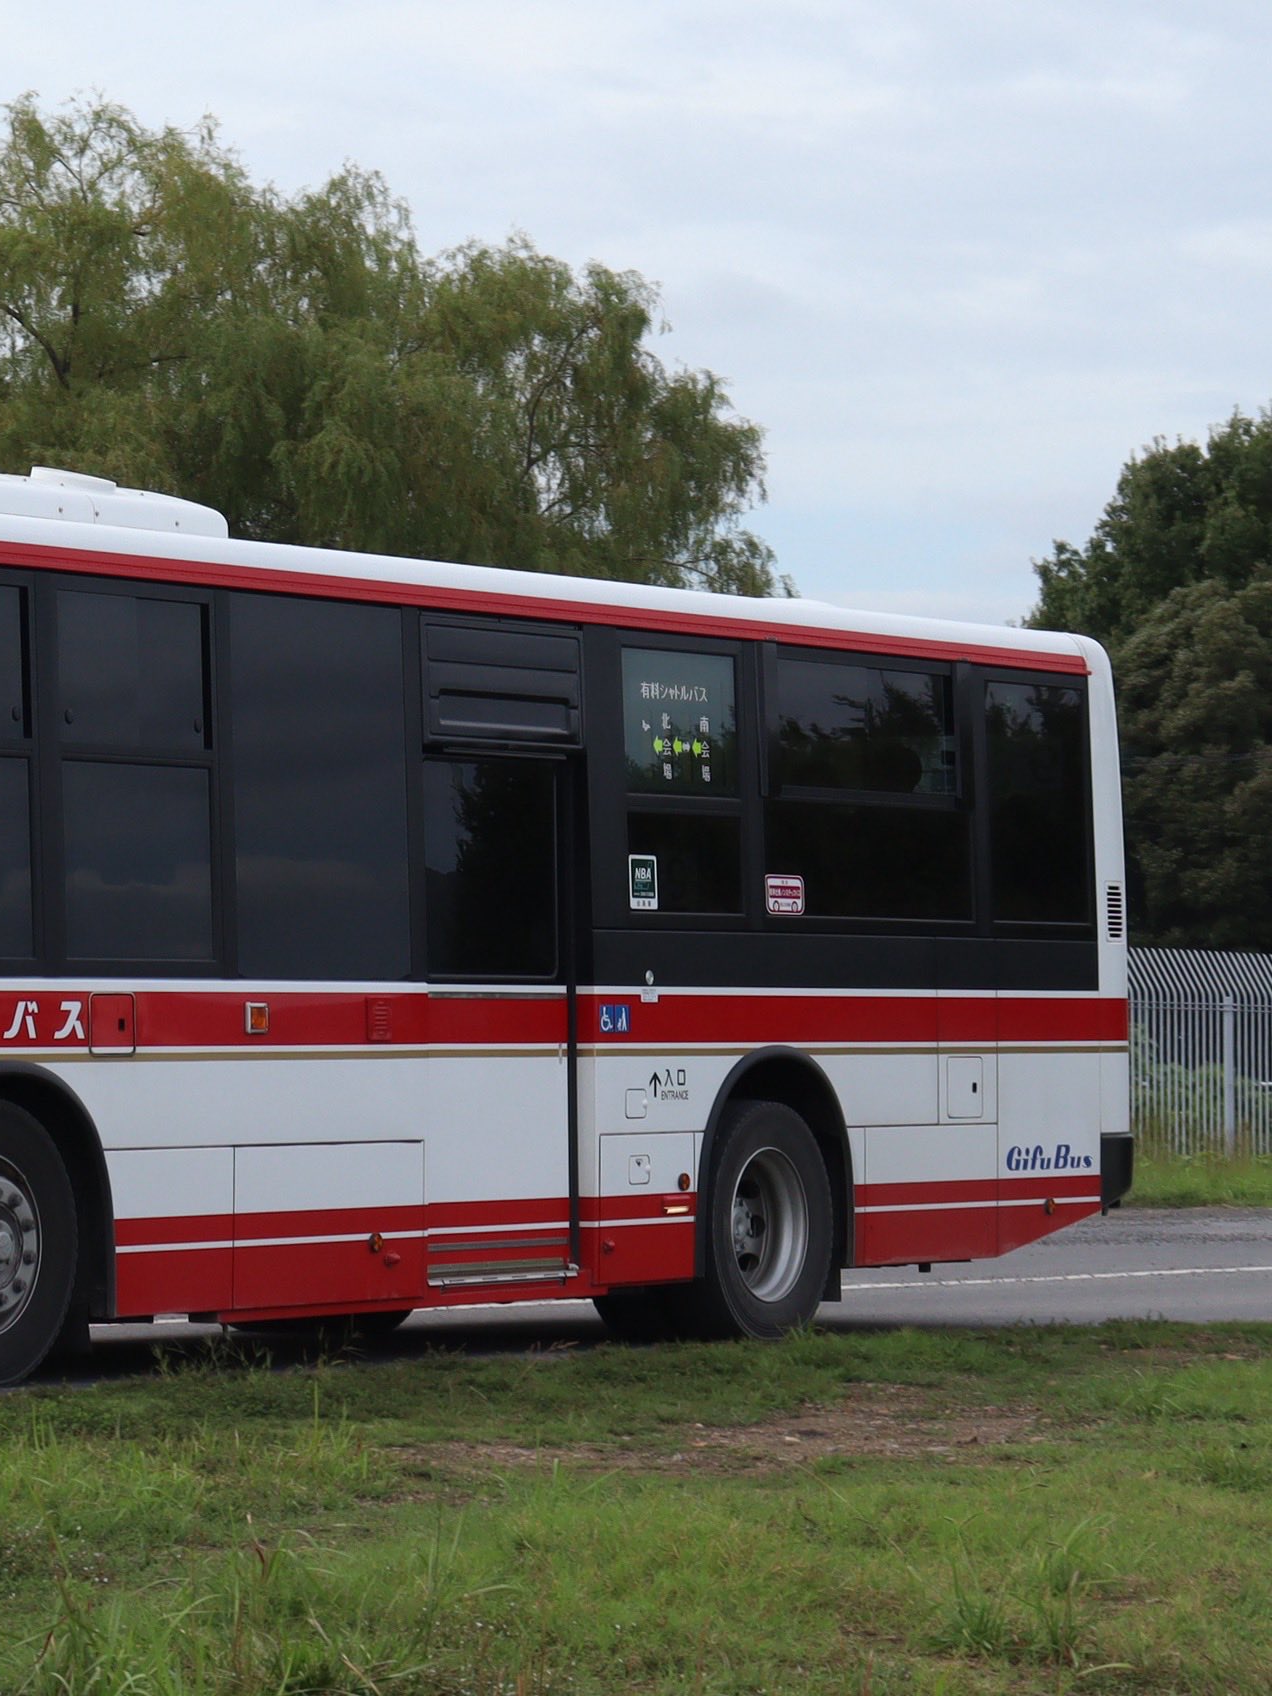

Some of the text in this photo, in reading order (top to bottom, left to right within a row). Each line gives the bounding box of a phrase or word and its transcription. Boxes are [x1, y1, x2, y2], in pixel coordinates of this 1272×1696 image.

[640, 681, 708, 702] 有料シャトルバス
[634, 867, 652, 880] NBA
[664, 1069, 686, 1087] 入口
[661, 1090, 689, 1101] ENTRANCE
